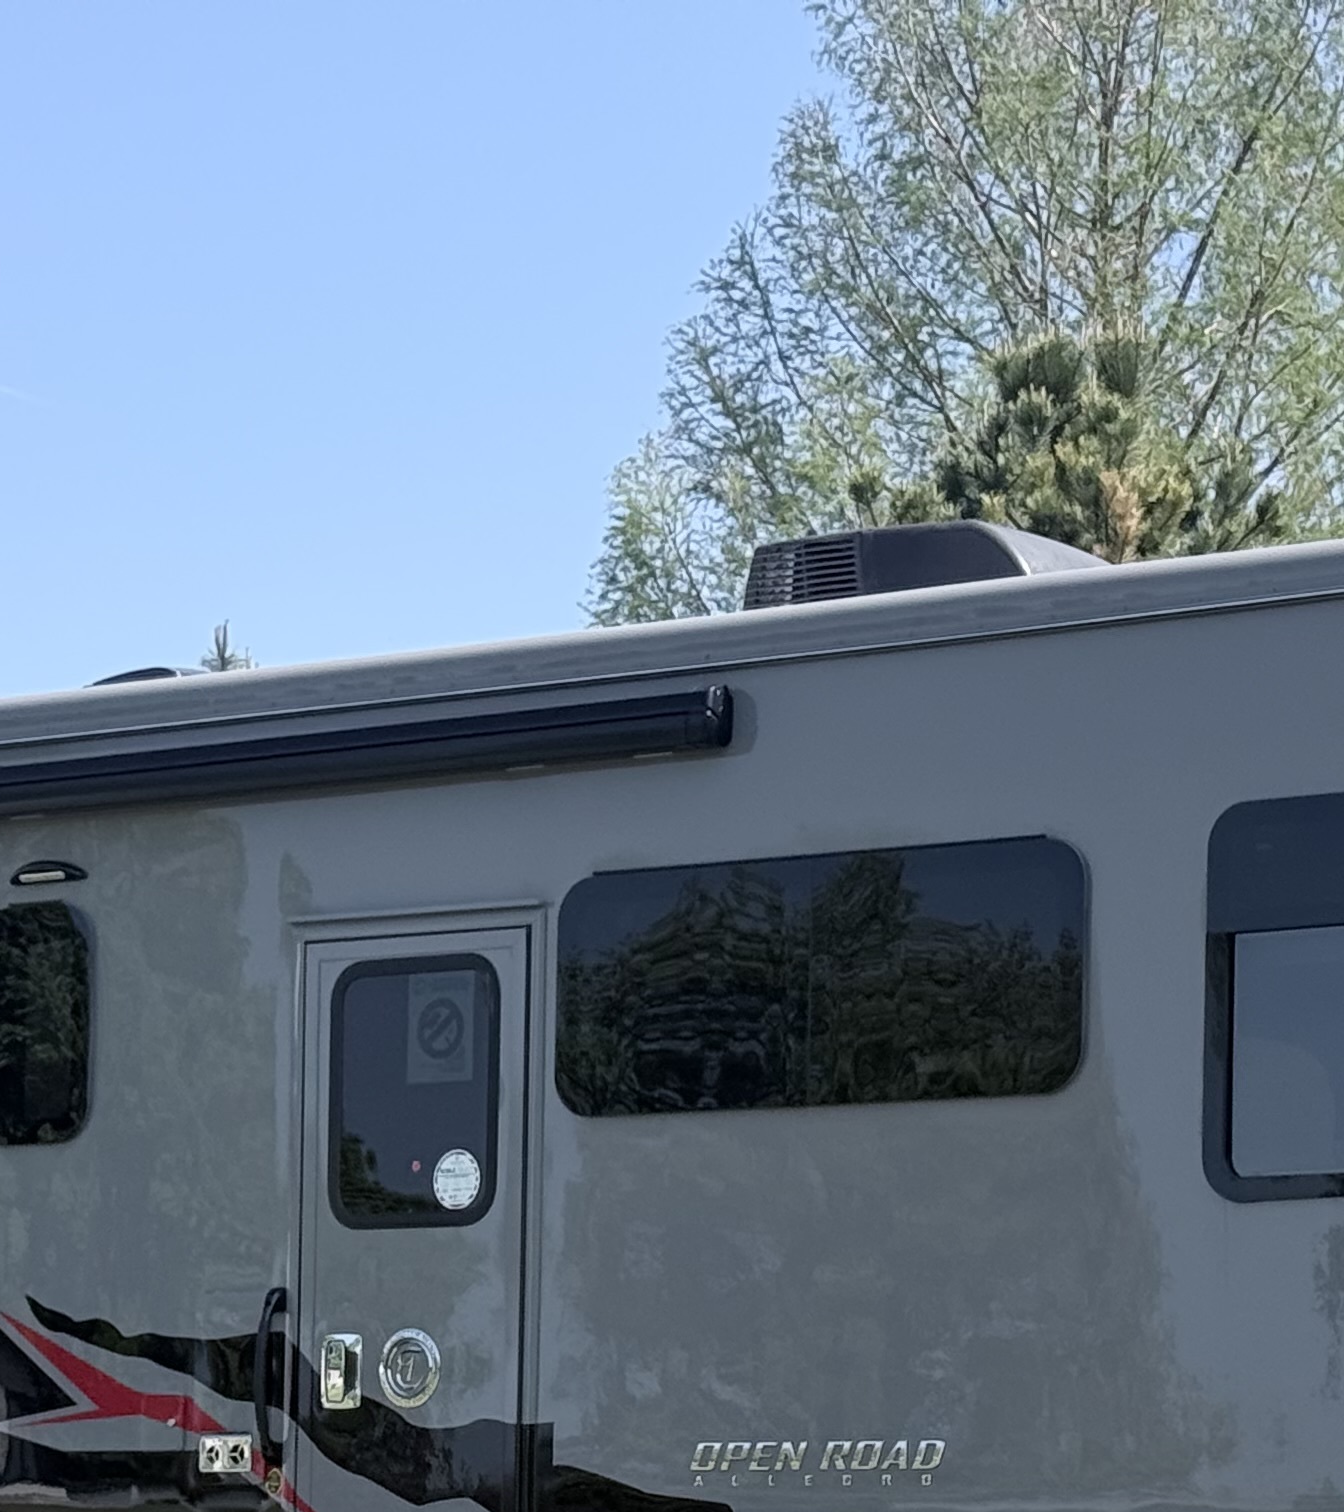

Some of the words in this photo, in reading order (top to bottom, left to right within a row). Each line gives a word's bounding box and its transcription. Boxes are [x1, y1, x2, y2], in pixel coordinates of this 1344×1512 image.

[690, 1440, 808, 1471] OPEN
[819, 1439, 946, 1470] ROAD
[693, 1474, 933, 1487] ALLEGRO
